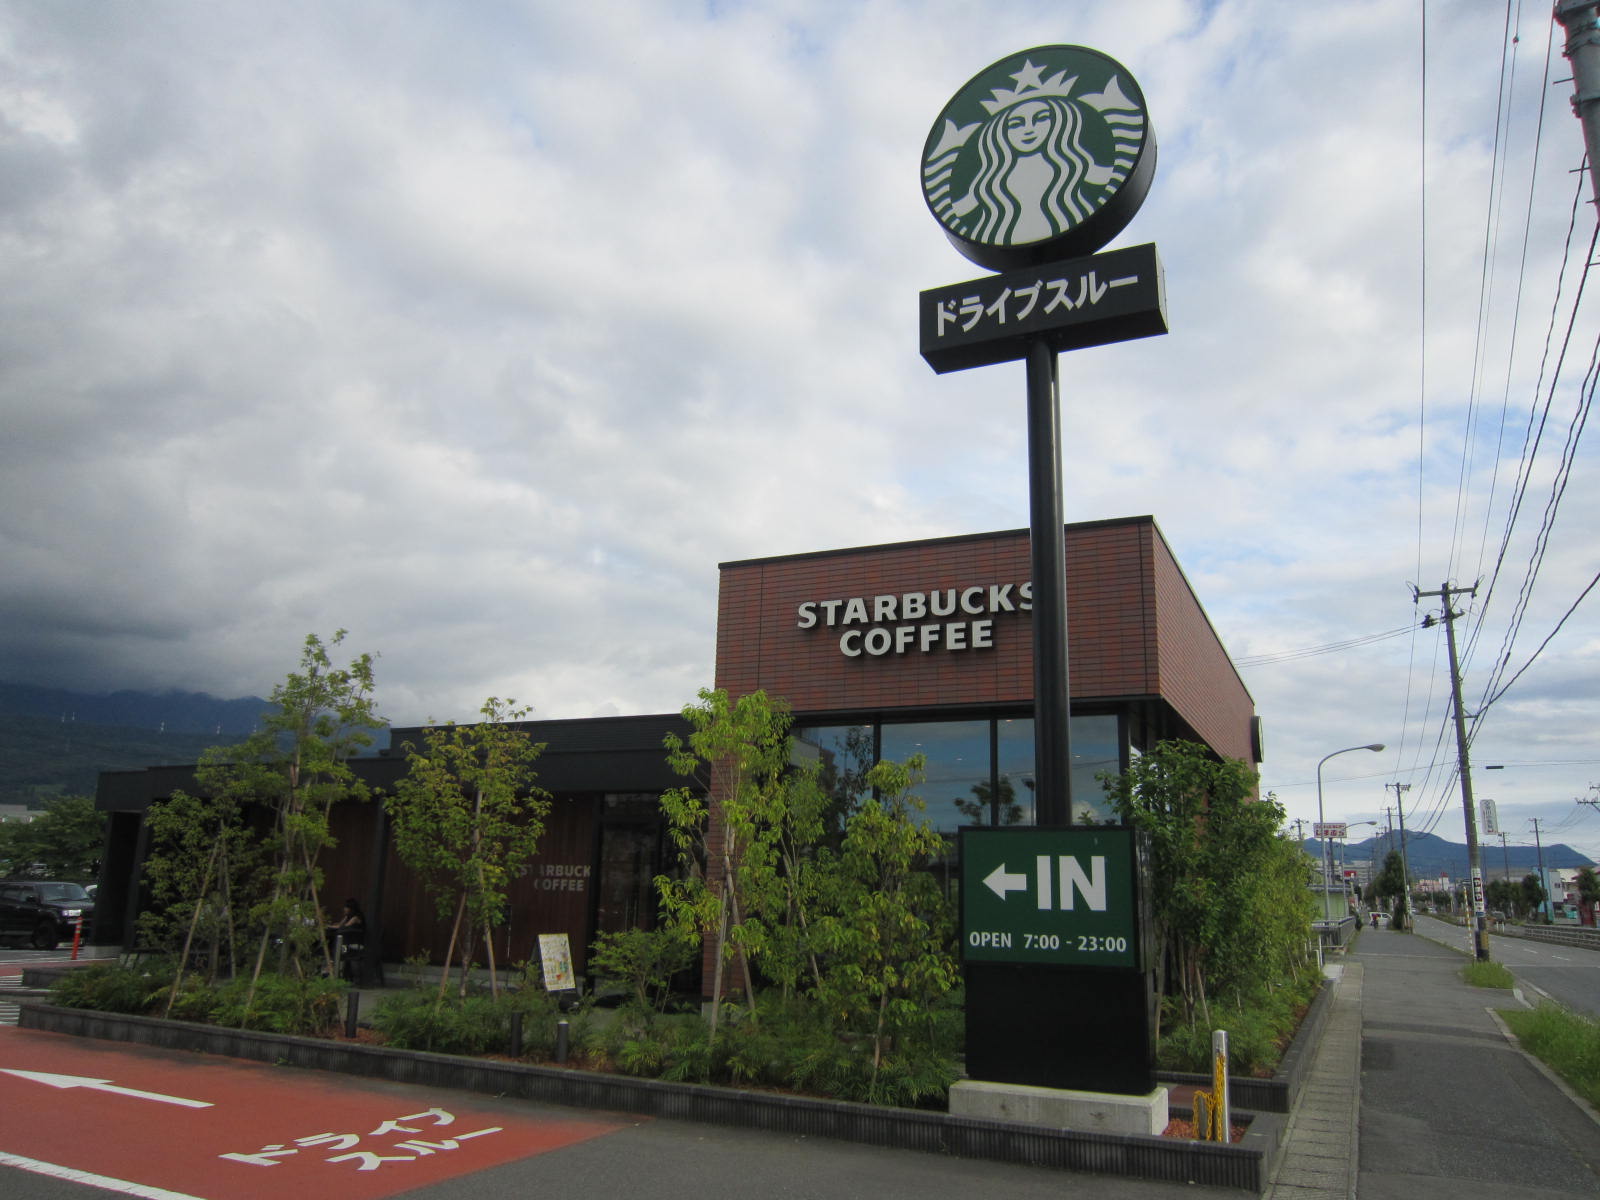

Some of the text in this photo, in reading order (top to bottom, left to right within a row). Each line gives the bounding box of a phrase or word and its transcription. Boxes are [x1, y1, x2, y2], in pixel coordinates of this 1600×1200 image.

[937, 271, 1139, 337] ドライブスルー
[839, 619, 994, 657] COFFEE
[1036, 855, 1107, 912] IN
[969, 931, 1012, 948] OPEN
[1023, 934, 1060, 949] 7:00
[1078, 936, 1127, 952] 23:00
[324, 1127, 504, 1171] スルー
